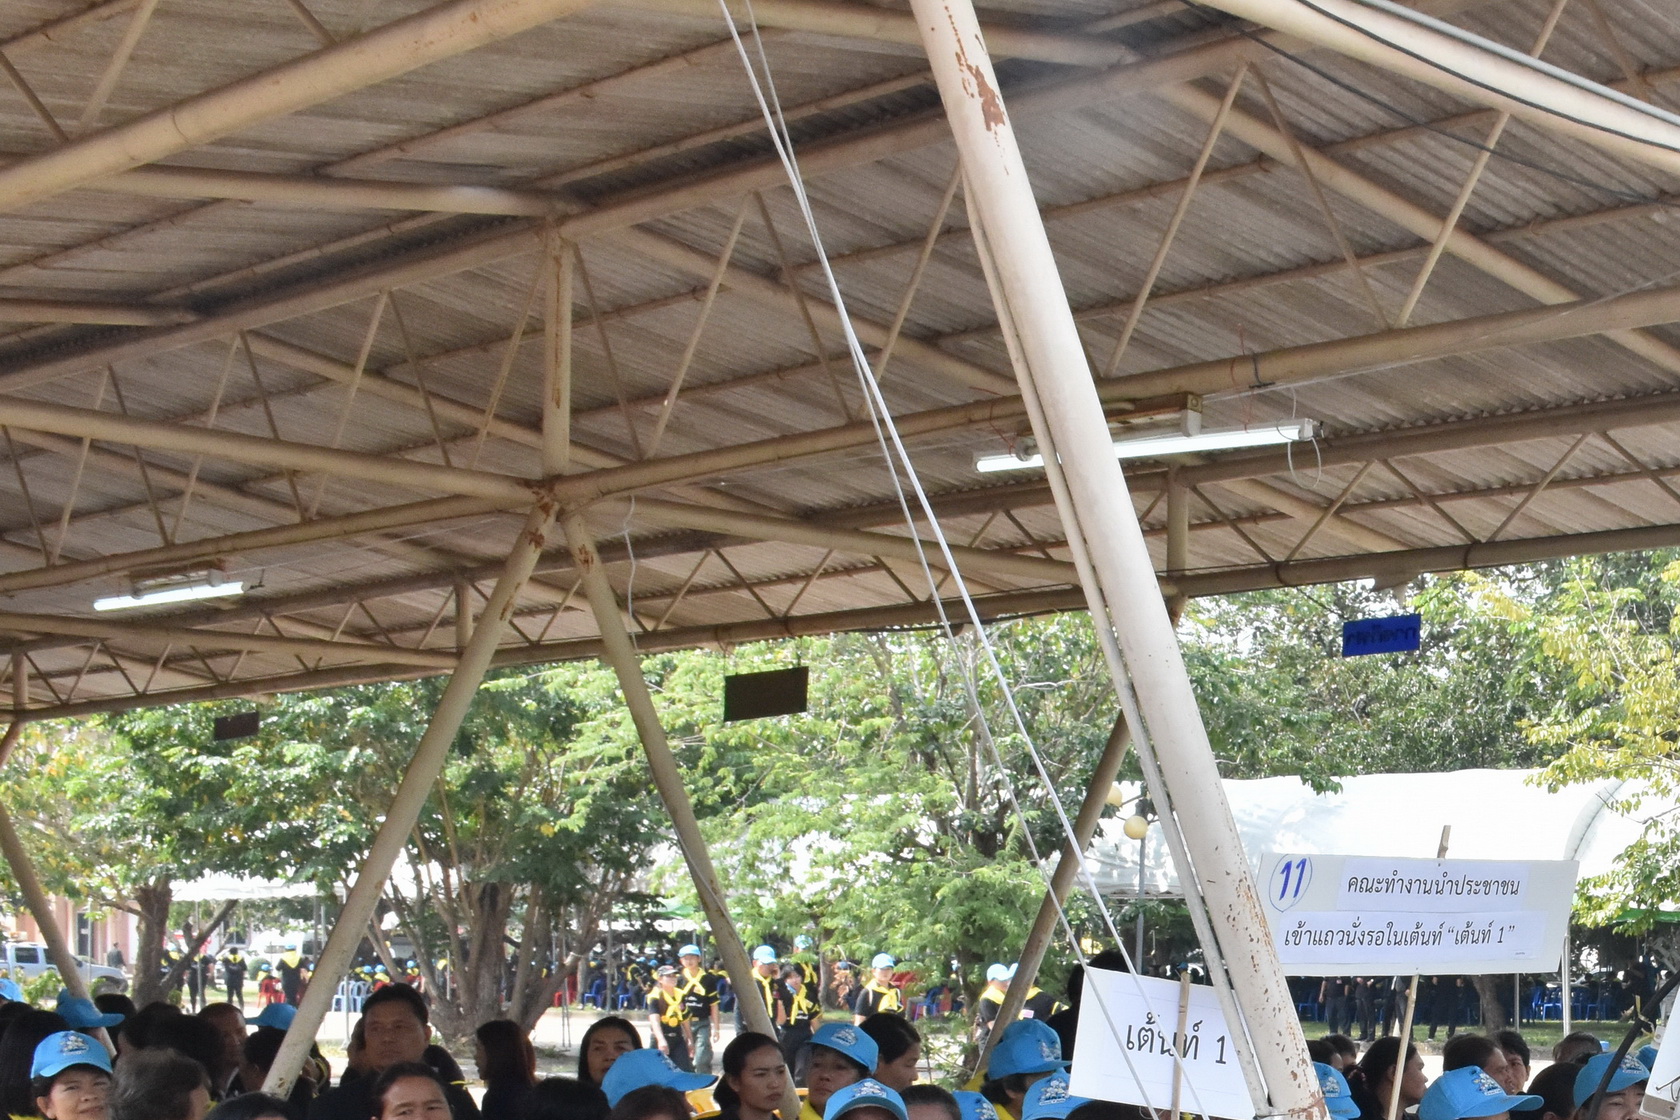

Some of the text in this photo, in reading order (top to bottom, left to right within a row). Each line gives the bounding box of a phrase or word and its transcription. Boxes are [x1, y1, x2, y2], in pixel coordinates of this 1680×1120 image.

[1278, 857, 1308, 901] 11
[1347, 869, 1521, 896] คณะทำงานนำประชาชน
[1215, 1034, 1227, 1065] 1
